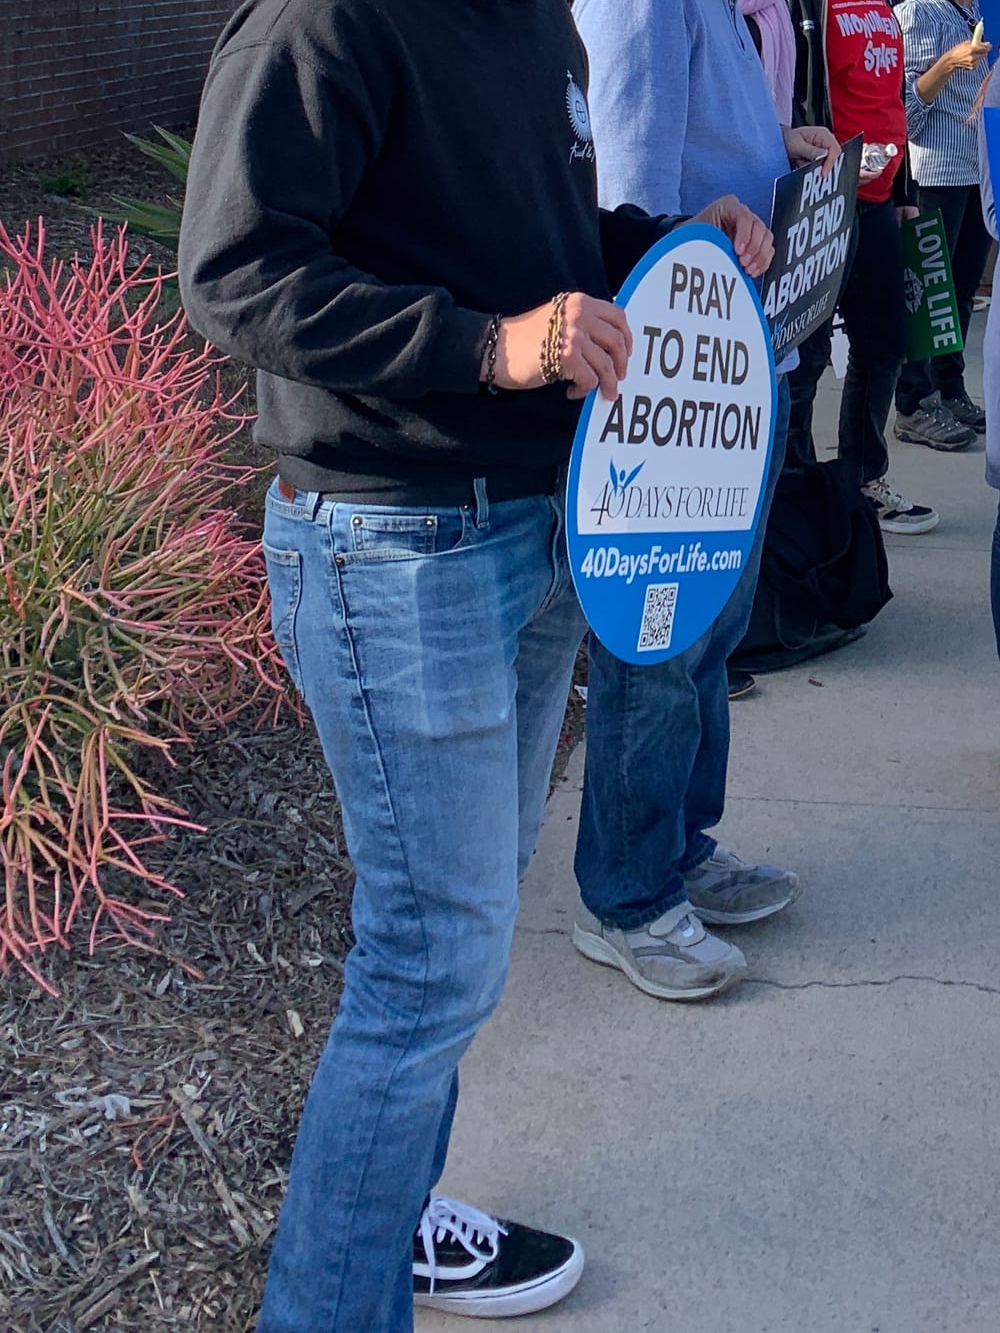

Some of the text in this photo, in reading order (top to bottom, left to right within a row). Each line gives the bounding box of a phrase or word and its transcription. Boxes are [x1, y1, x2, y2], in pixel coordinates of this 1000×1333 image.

[864, 41, 899, 77] STAFF
[800, 152, 845, 213] PRAY
[786, 194, 845, 265] TO END
[669, 262, 737, 320] PRAY
[764, 227, 850, 320] ABORTION
[915, 218, 958, 350] LOVE LIFE
[643, 325, 749, 385] TO END
[599, 394, 761, 450] ABORTION
[580, 542, 742, 584] 40DaysForLife.com
